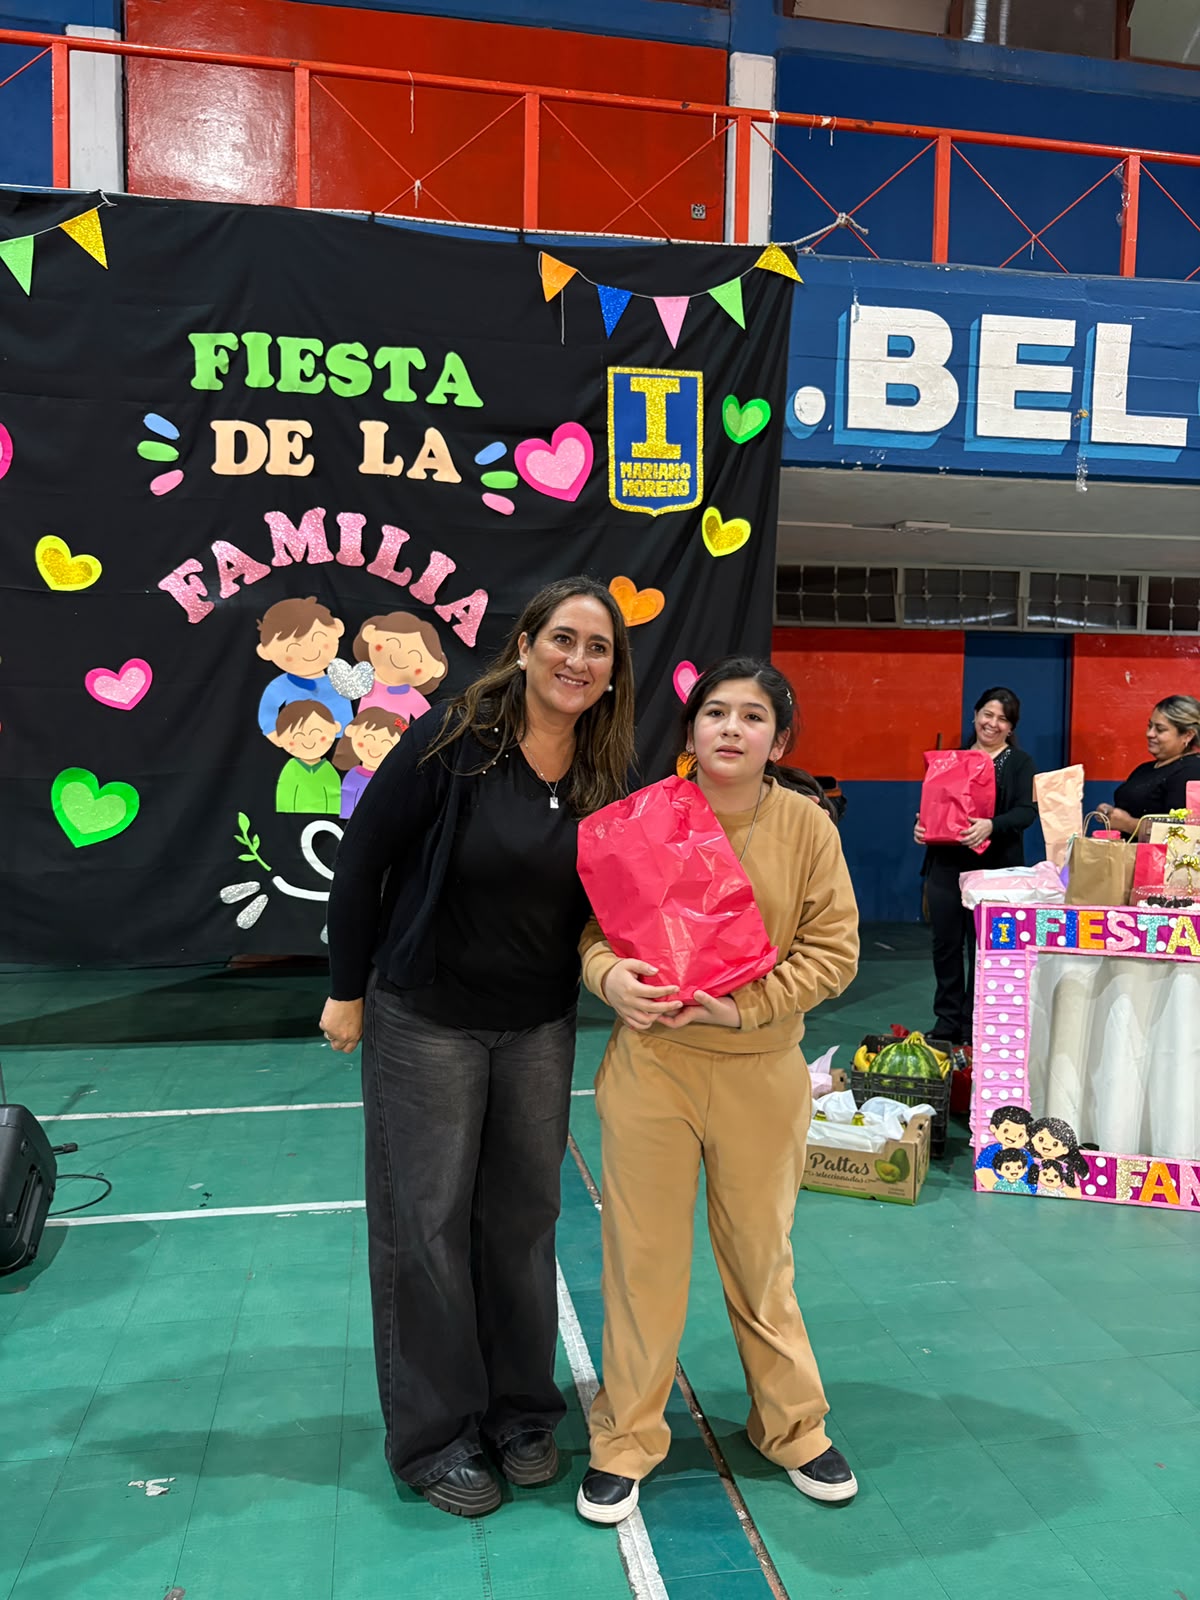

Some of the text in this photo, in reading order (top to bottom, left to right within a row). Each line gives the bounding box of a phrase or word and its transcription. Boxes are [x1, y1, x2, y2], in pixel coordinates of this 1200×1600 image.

[188, 331, 484, 408] FIESTA
[630, 376, 682, 459] I
[210, 419, 462, 483] DE LA
[620, 462, 691, 480] MARIANO
[622, 479, 690, 497] MORENO
[158, 507, 489, 648] FAMILIA
[1036, 909, 1200, 956] FIESTA
[809, 1153, 870, 1176] Paltas
[815, 1171, 865, 1183] seleccionadas
